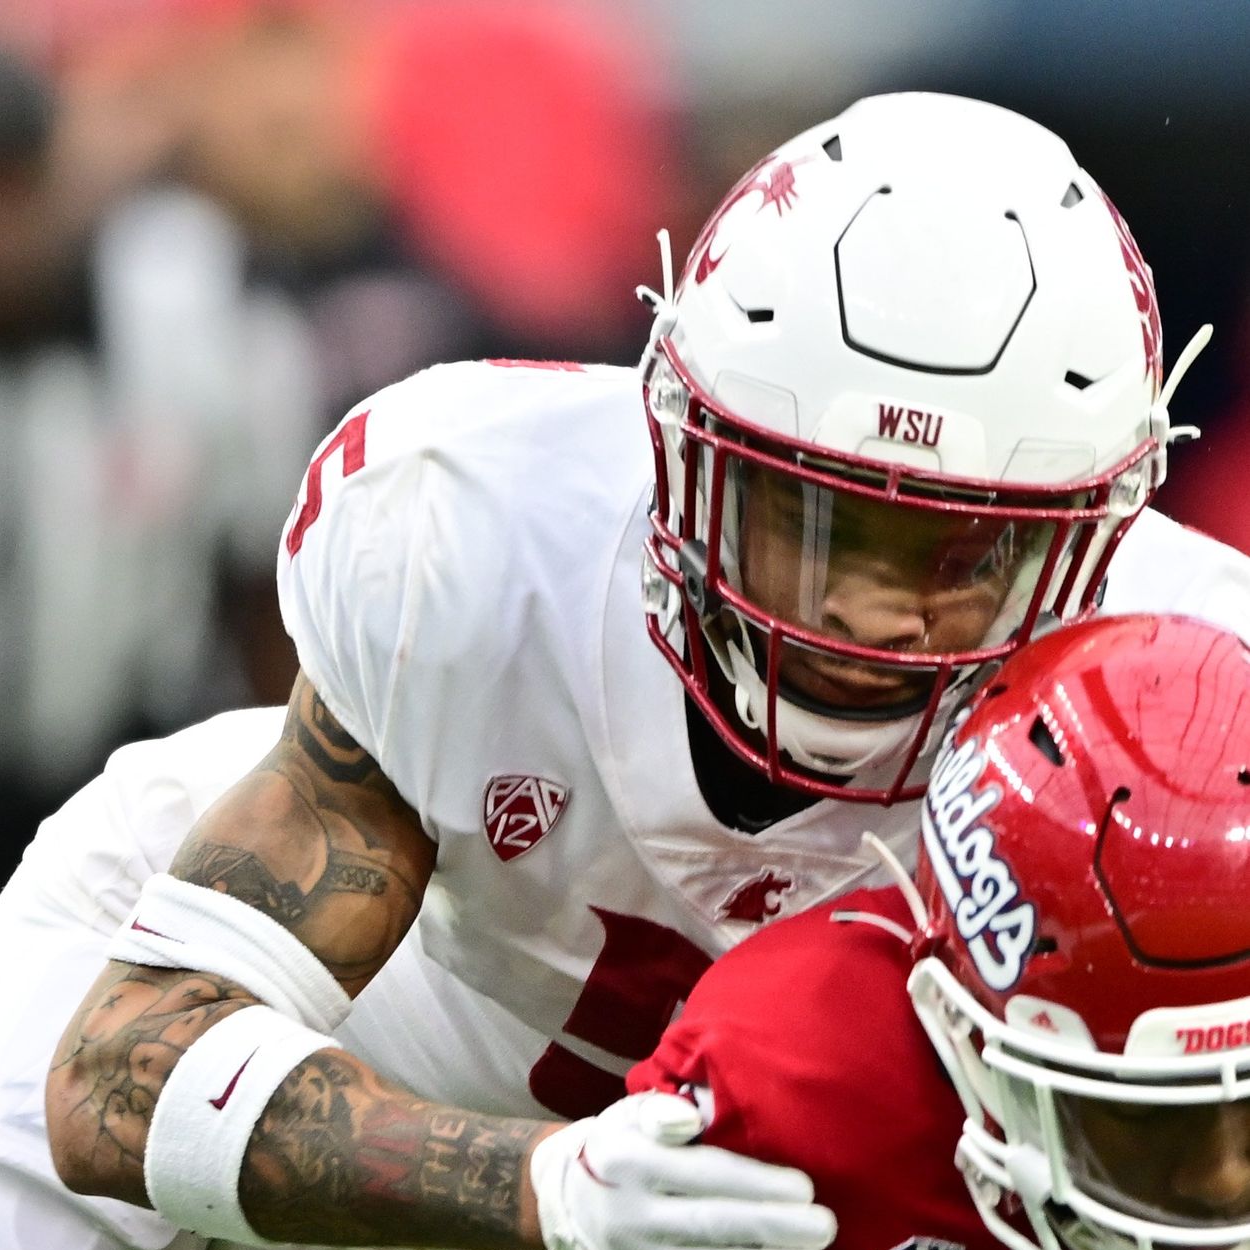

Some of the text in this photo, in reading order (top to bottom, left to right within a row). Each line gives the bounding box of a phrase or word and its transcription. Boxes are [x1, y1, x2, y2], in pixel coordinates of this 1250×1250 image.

[878, 403, 943, 447] WSU
[487, 777, 566, 834] PAC
[493, 812, 538, 848] 12
[922, 706, 1035, 991] lldogs
[1176, 1019, 1250, 1056] 'DOG
